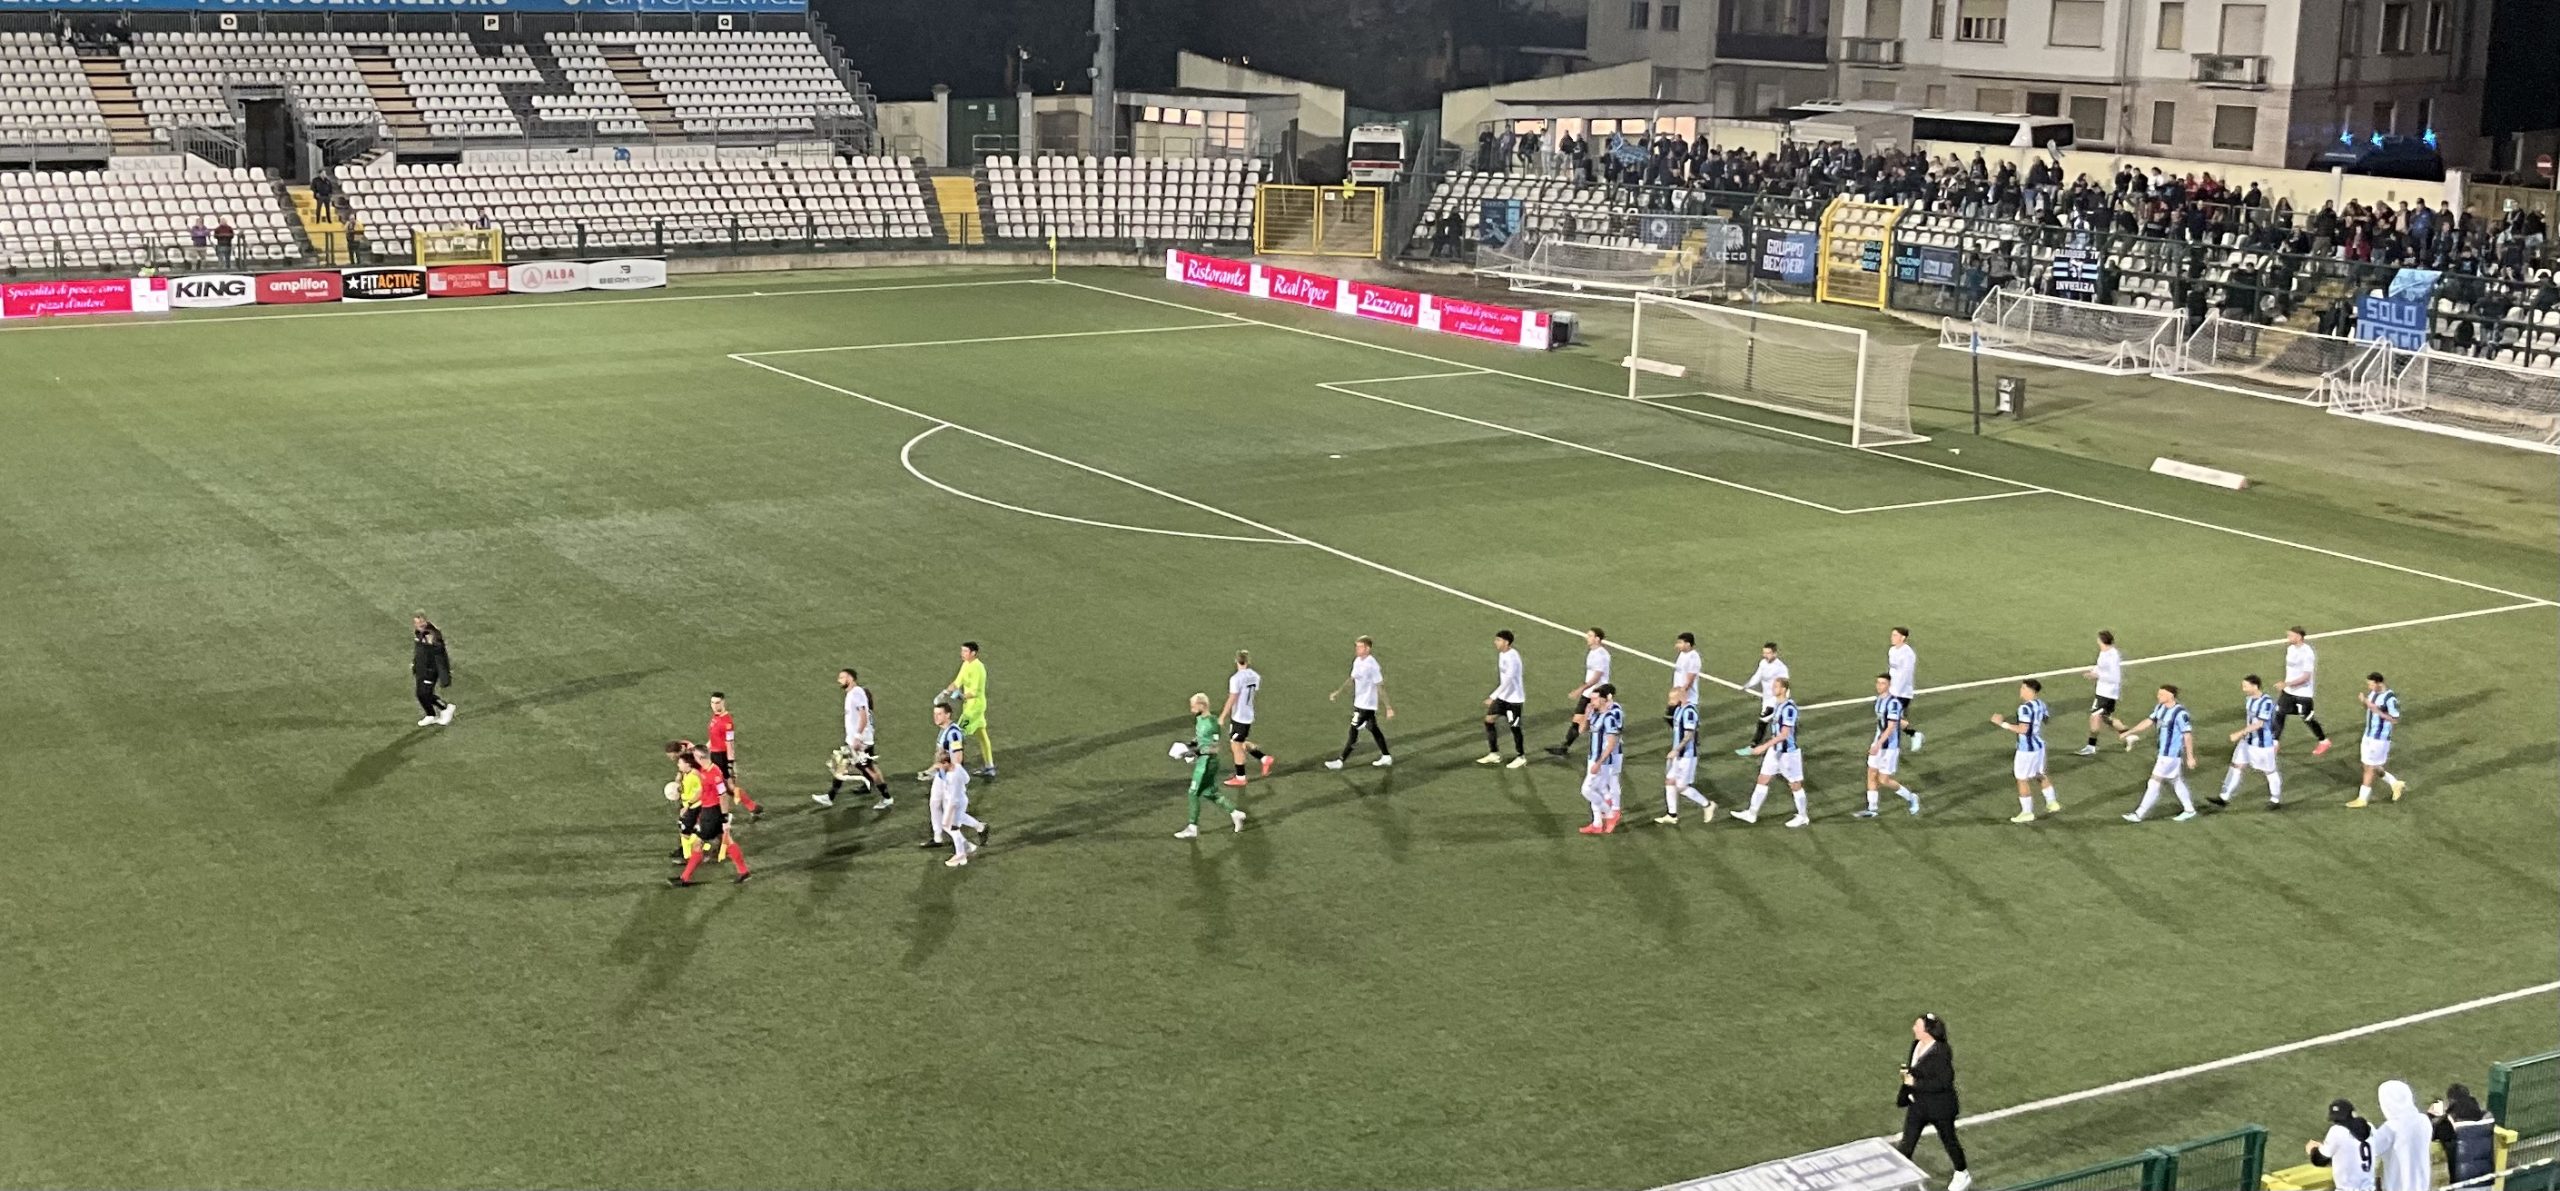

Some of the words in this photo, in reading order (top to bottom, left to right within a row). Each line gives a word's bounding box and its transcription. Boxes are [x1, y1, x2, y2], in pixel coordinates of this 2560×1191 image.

[487, 18, 496, 27] P
[1766, 238, 1804, 257] GRUPPO
[546, 268, 575, 280] ALBA
[1187, 259, 1246, 287] Ristorante
[175, 280, 246, 298] KING
[269, 277, 328, 294] amplifon
[1274, 274, 1300, 297] Real
[1301, 278, 1330, 305] Piper
[1361, 289, 1414, 319] Pizzeria
[2366, 297, 2417, 327] SOLO
[2359, 1141, 2372, 1173] 9
